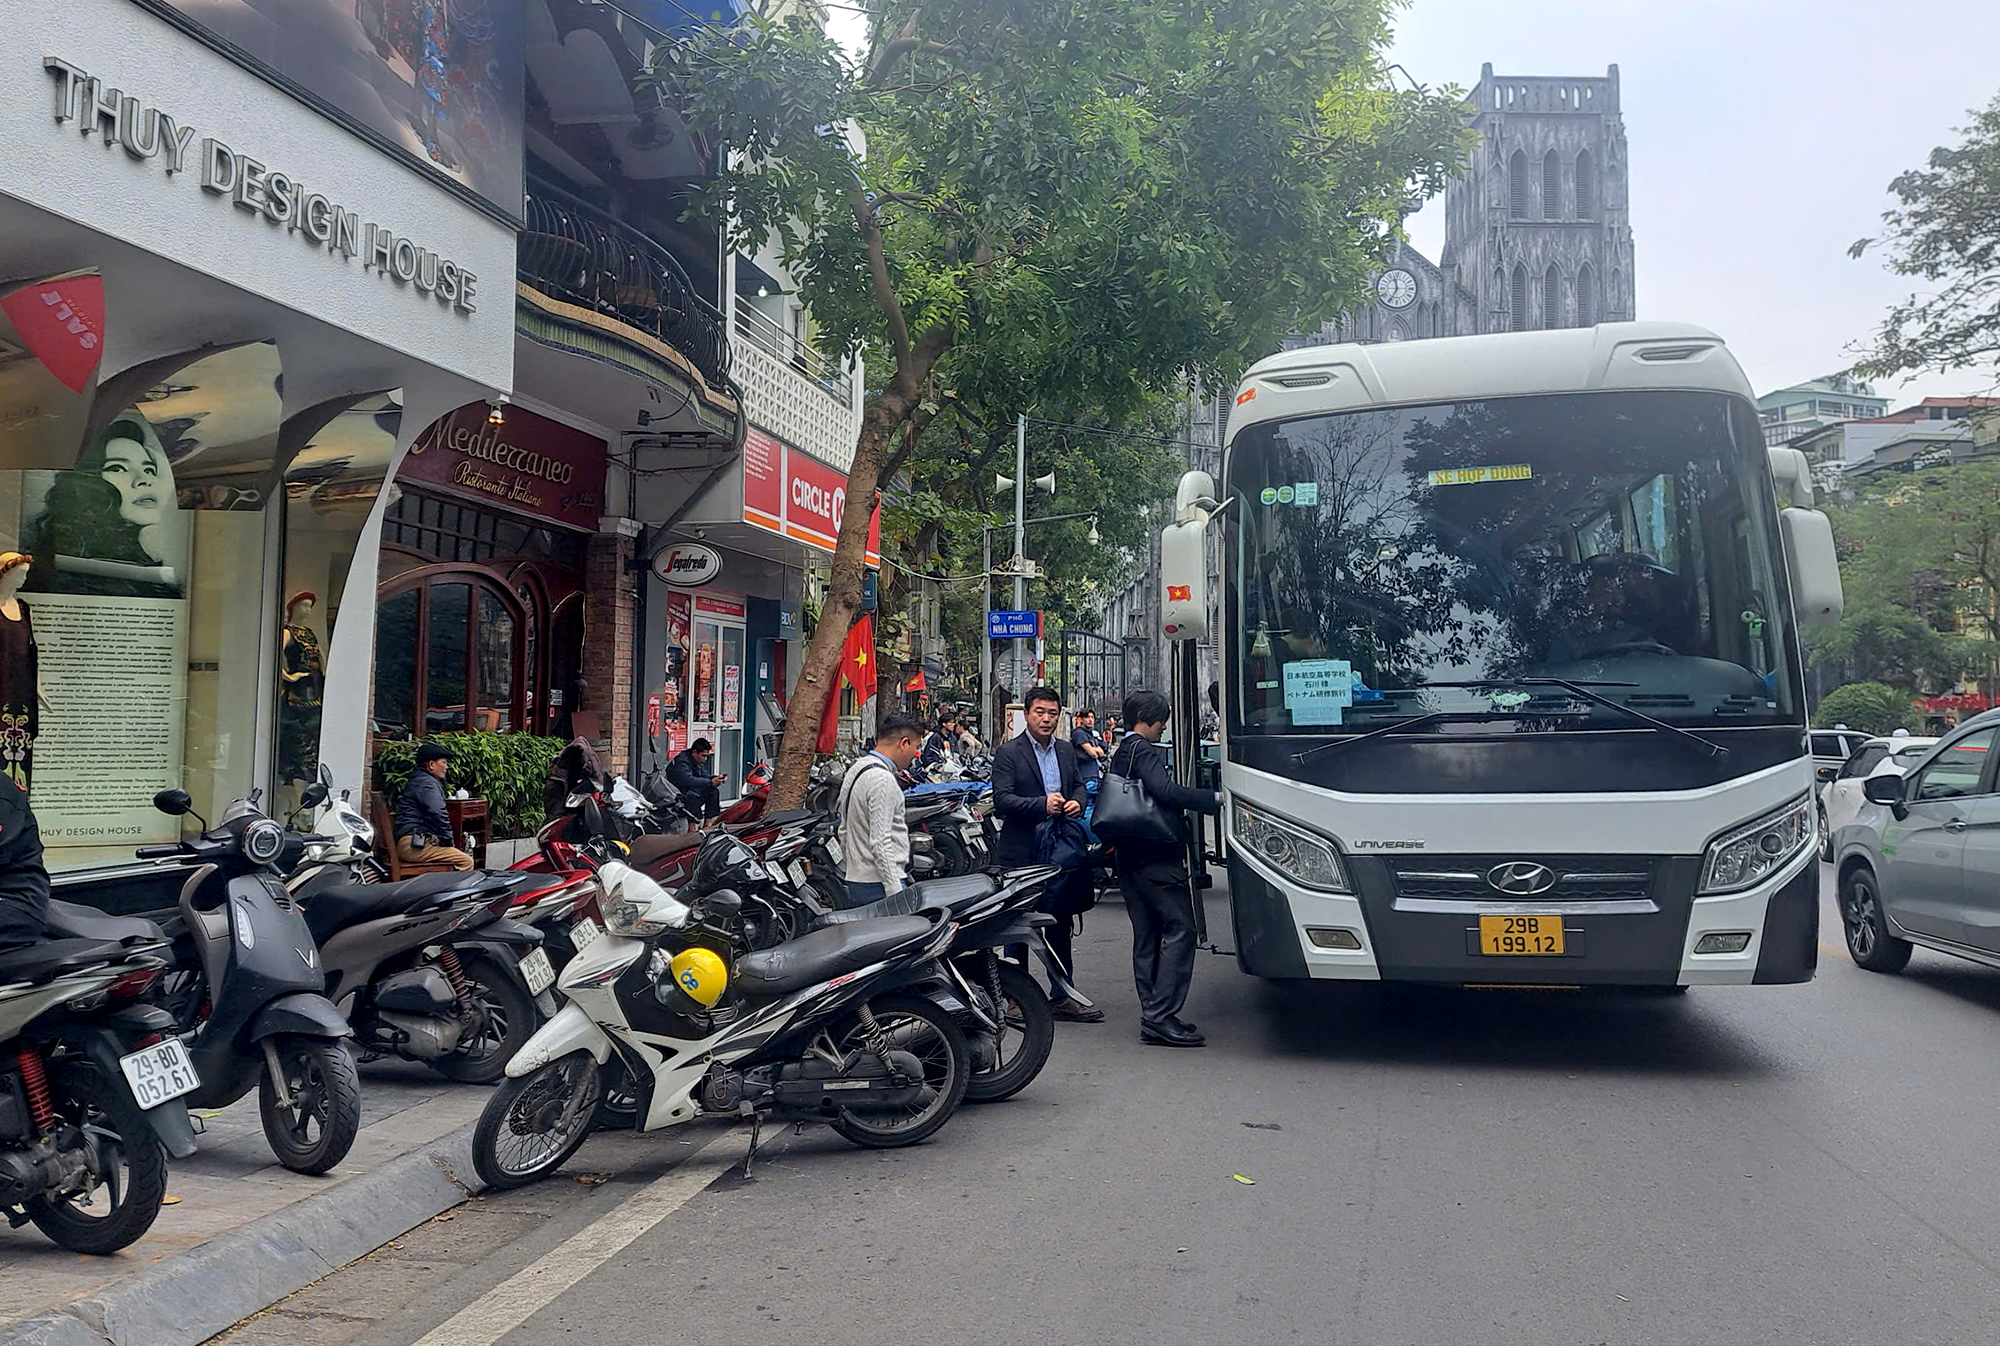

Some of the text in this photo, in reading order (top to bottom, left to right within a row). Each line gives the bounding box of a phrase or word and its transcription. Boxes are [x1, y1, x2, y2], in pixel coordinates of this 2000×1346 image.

[43, 56, 477, 314] THUY DESIGN HOUSE
[40, 290, 98, 349] SALE
[411, 410, 573, 485] Mediterraneo
[454, 460, 510, 496] Ristorante
[508, 475, 543, 508] Italiano
[1434, 470, 1453, 484] XE
[792, 477, 831, 519] CIRCLE
[662, 551, 708, 573] Segafredo
[992, 622, 1034, 634] NHÀ CHUNG
[1286, 689, 1347, 698] ベトナム研修旅行
[40, 826, 142, 837] HUY DESIGN HOUSE
[1354, 840, 1426, 849] UNIVERSE
[1503, 917, 1539, 934] 29B
[1492, 936, 1556, 953] 199.12
[680, 966, 699, 991] be
[131, 1045, 179, 1079] 29-BD
[137, 1066, 194, 1104] 052.61
